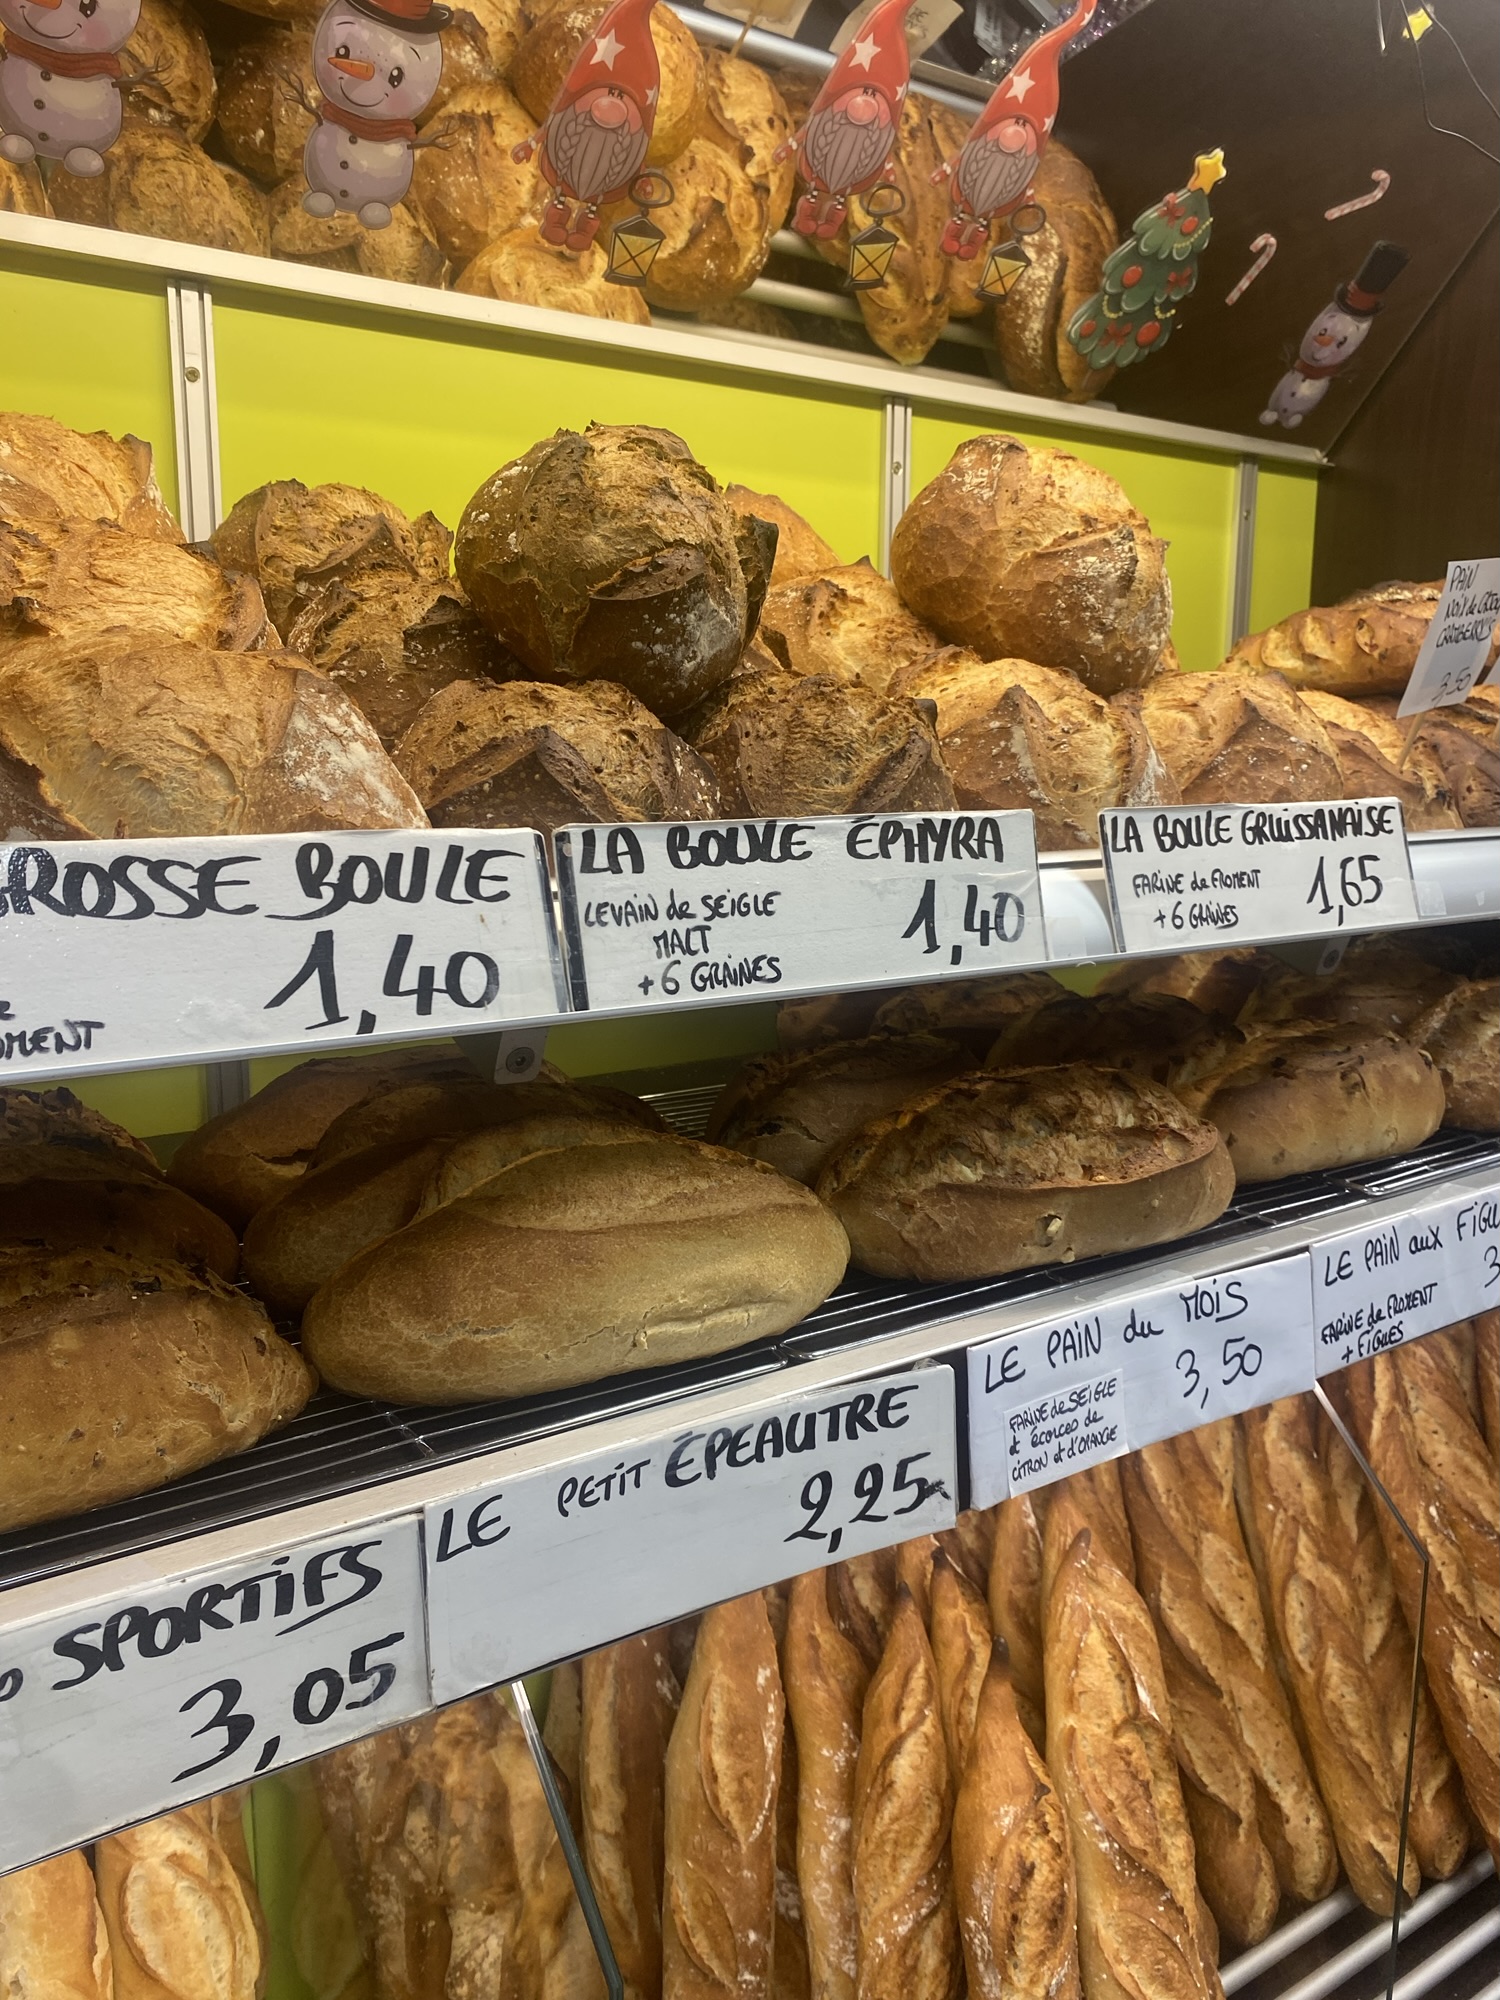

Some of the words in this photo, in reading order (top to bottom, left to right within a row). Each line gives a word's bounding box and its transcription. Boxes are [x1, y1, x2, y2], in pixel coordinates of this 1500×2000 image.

[580, 827, 645, 874] LA
[846, 815, 1004, 863] ÉPHYRA
[1111, 815, 1143, 852] LA
[1154, 810, 1233, 852] BOULE
[265, 843, 525, 920] BOULE
[667, 888, 697, 919] de
[1190, 872, 1210, 891] de
[1306, 855, 1383, 927] 1,65
[653, 925, 711, 958] MALT
[900, 879, 1025, 965] 1,40
[263, 930, 500, 1034] 1,40
[1324, 1251, 1353, 1287] LE
[1409, 1225, 1443, 1255] aux
[1367, 1302, 1387, 1328] de
[985, 1345, 1026, 1394] LE
[1123, 1309, 1164, 1343] du
[1176, 1336, 1262, 1410] 3,50
[1051, 1398, 1069, 1419] de
[1084, 1408, 1104, 1427] de
[436, 1494, 511, 1563] LE
[664, 1384, 919, 1489] ÉPEAUTRE
[1054, 1441, 1065, 1463] et
[783, 1452, 932, 1553] 2,25
[171, 1631, 405, 1784] 3,05
